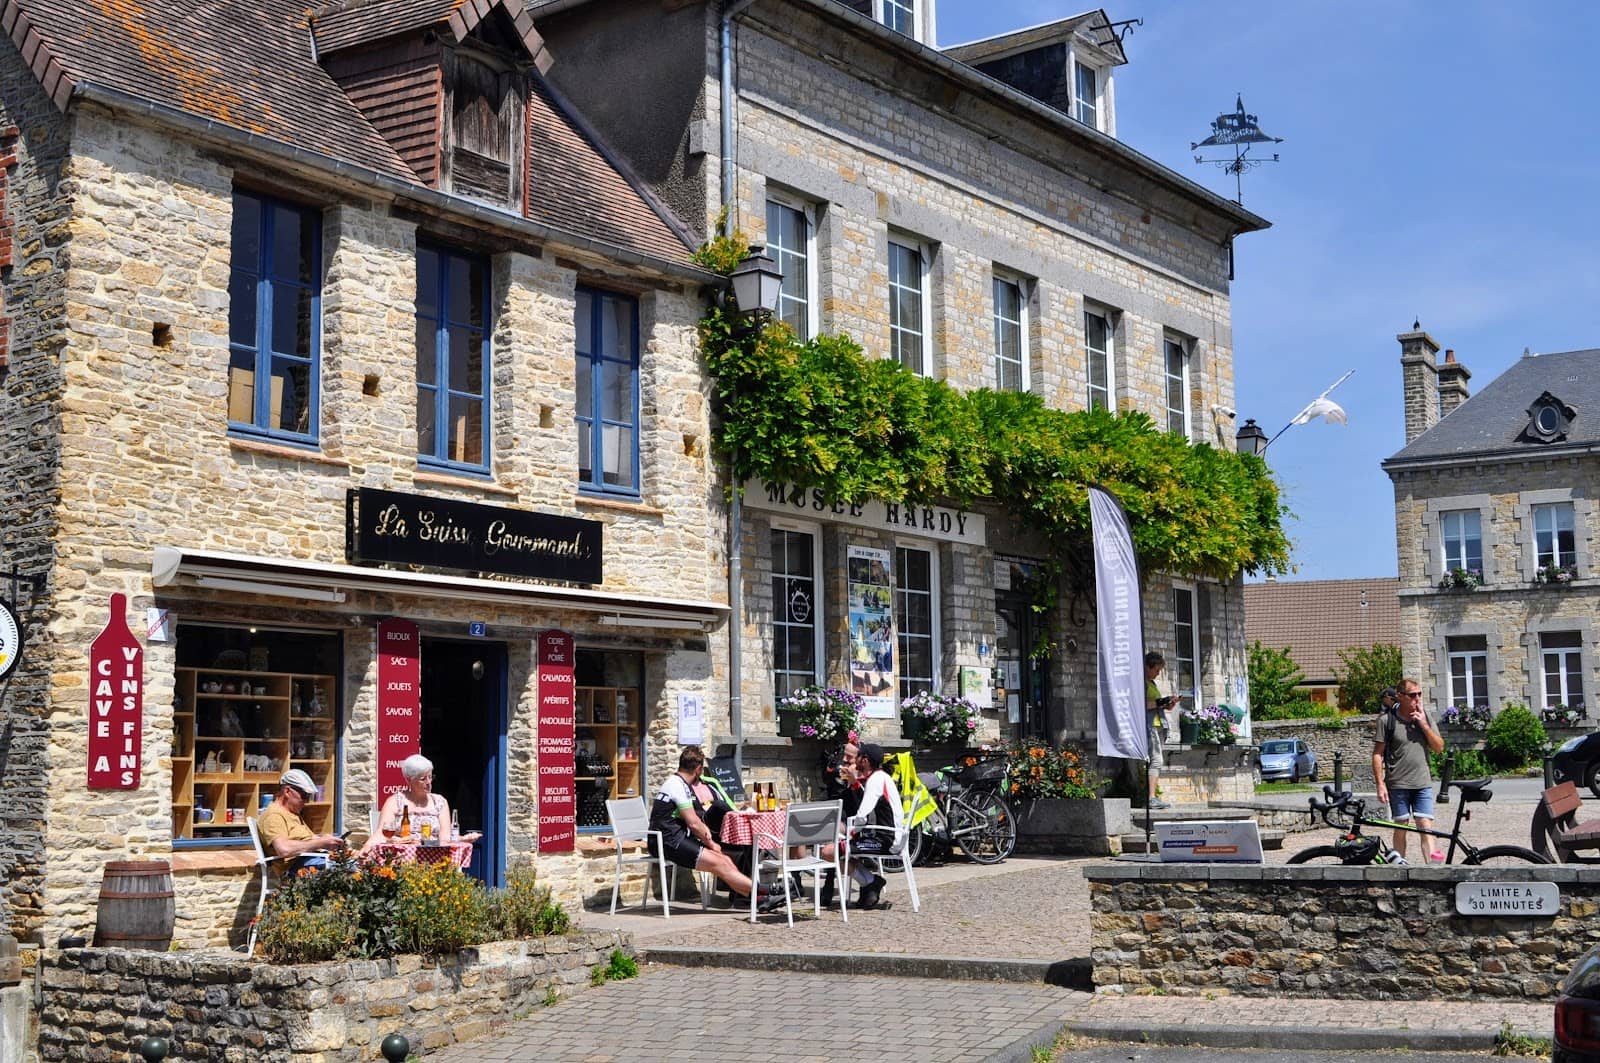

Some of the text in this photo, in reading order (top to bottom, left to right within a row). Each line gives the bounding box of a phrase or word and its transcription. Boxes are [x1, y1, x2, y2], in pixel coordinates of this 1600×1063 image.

[886, 501, 967, 536] HARDY
[474, 624, 481, 634] 2
[386, 631, 410, 641] BIJOUX
[390, 656, 408, 666] SACS
[541, 673, 571, 683] CALVADOS
[386, 681, 412, 691] JOUETS
[94, 659, 113, 772] CAVE A
[119, 646, 139, 786] VINS FINS
[385, 706, 413, 716] SAVONS
[539, 716, 573, 726] ANDOUILLE
[389, 732, 410, 744] DÉCO
[540, 737, 572, 746] FROMAGES
[540, 746, 572, 754] NORMANDS
[539, 766, 574, 775] CONSERVES
[545, 787, 569, 796] BISCUITS
[541, 795, 572, 804] PUR BEURRE
[539, 815, 574, 825] CONFITURES
[541, 836, 553, 844] Que
[560, 831, 570, 840] bon
[1480, 888, 1519, 897] LIMITE
[1472, 900, 1543, 910] 30 MINUTES
